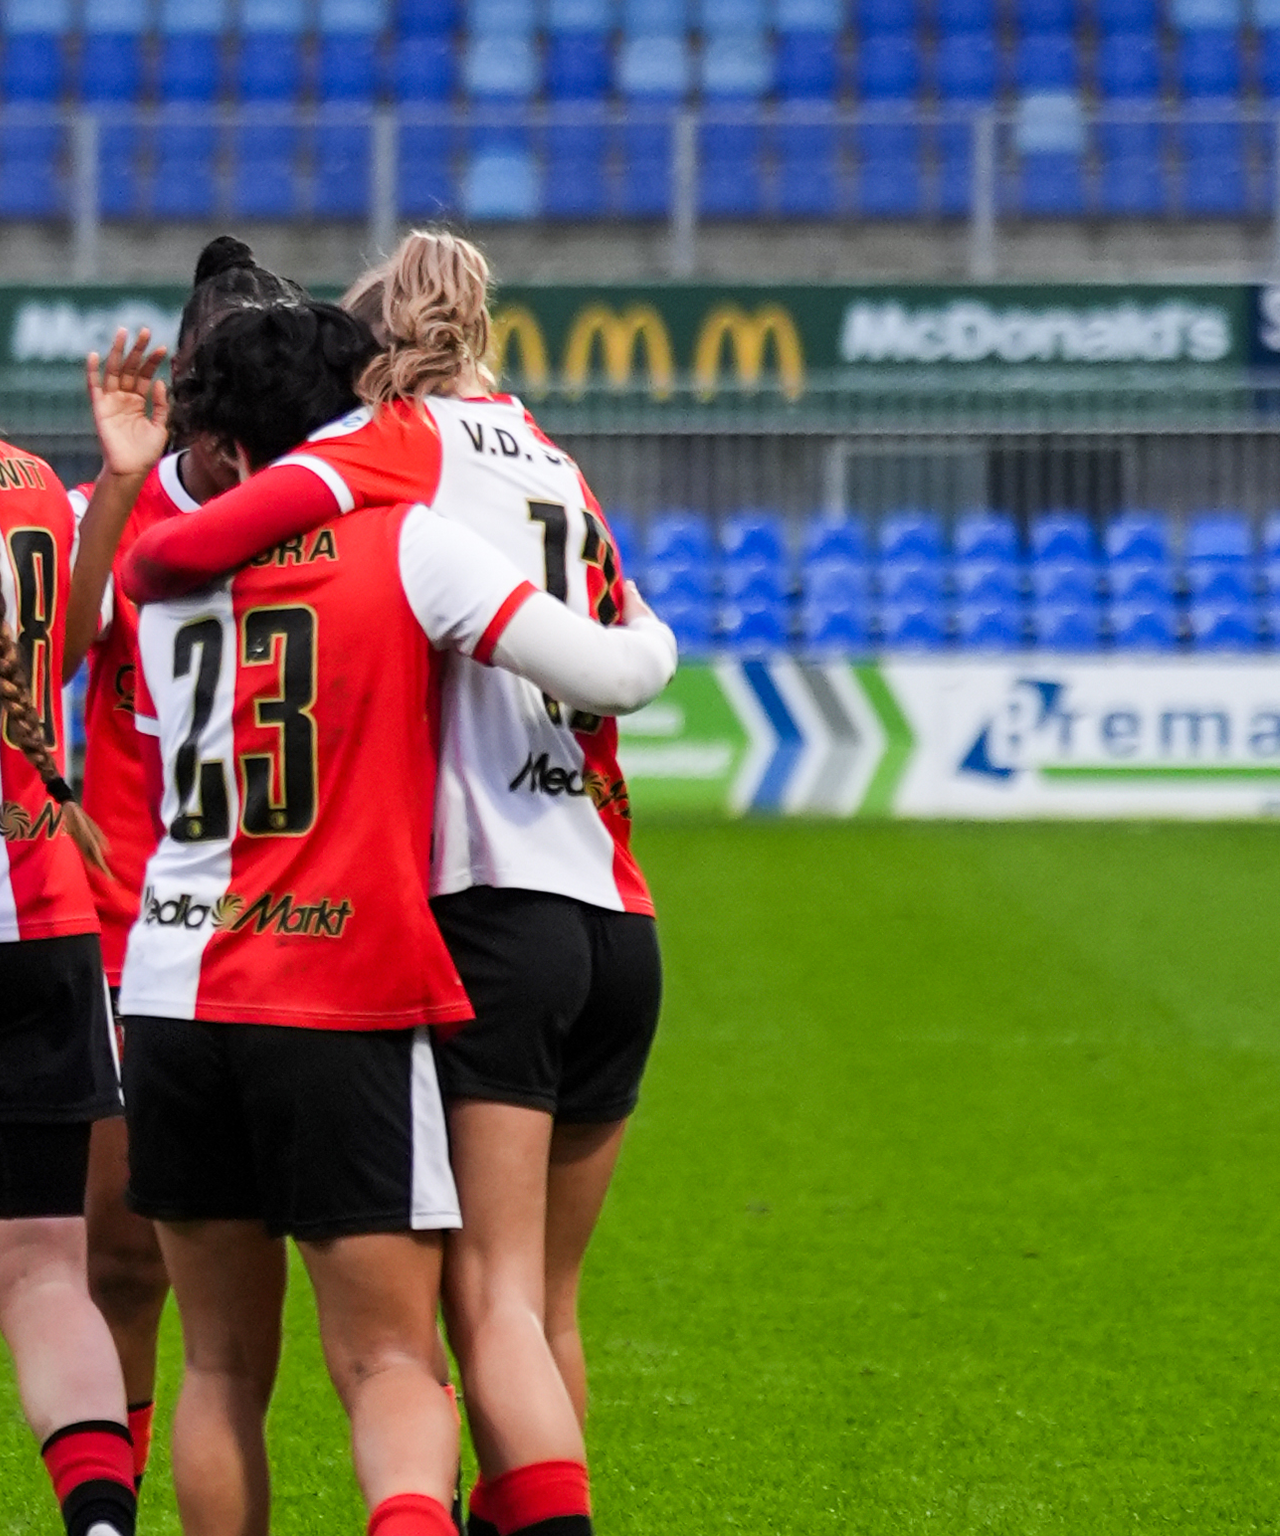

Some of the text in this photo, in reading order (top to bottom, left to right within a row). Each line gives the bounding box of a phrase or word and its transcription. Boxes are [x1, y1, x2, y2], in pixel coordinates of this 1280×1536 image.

[842, 299, 1231, 363] McDonald's
[169, 603, 319, 844] 23
[233, 891, 355, 938] Markt
